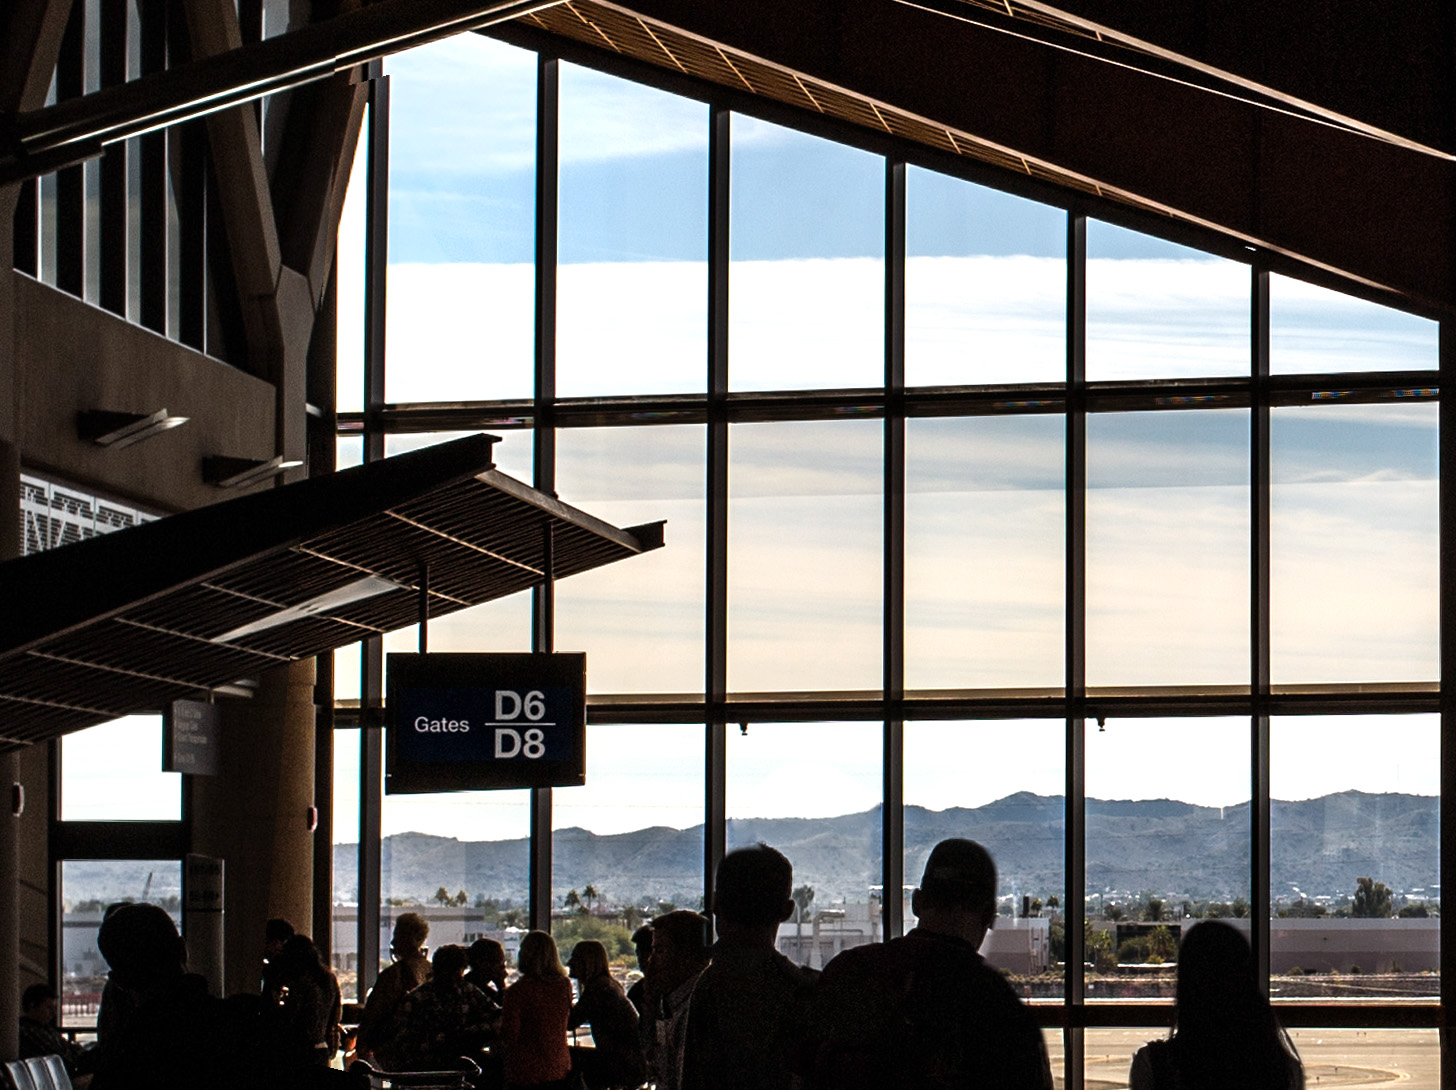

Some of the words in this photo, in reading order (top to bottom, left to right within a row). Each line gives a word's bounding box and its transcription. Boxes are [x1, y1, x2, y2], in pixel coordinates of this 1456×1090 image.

[496, 691, 545, 720] D6
[415, 717, 469, 732] Gates
[495, 729, 545, 758] D8
